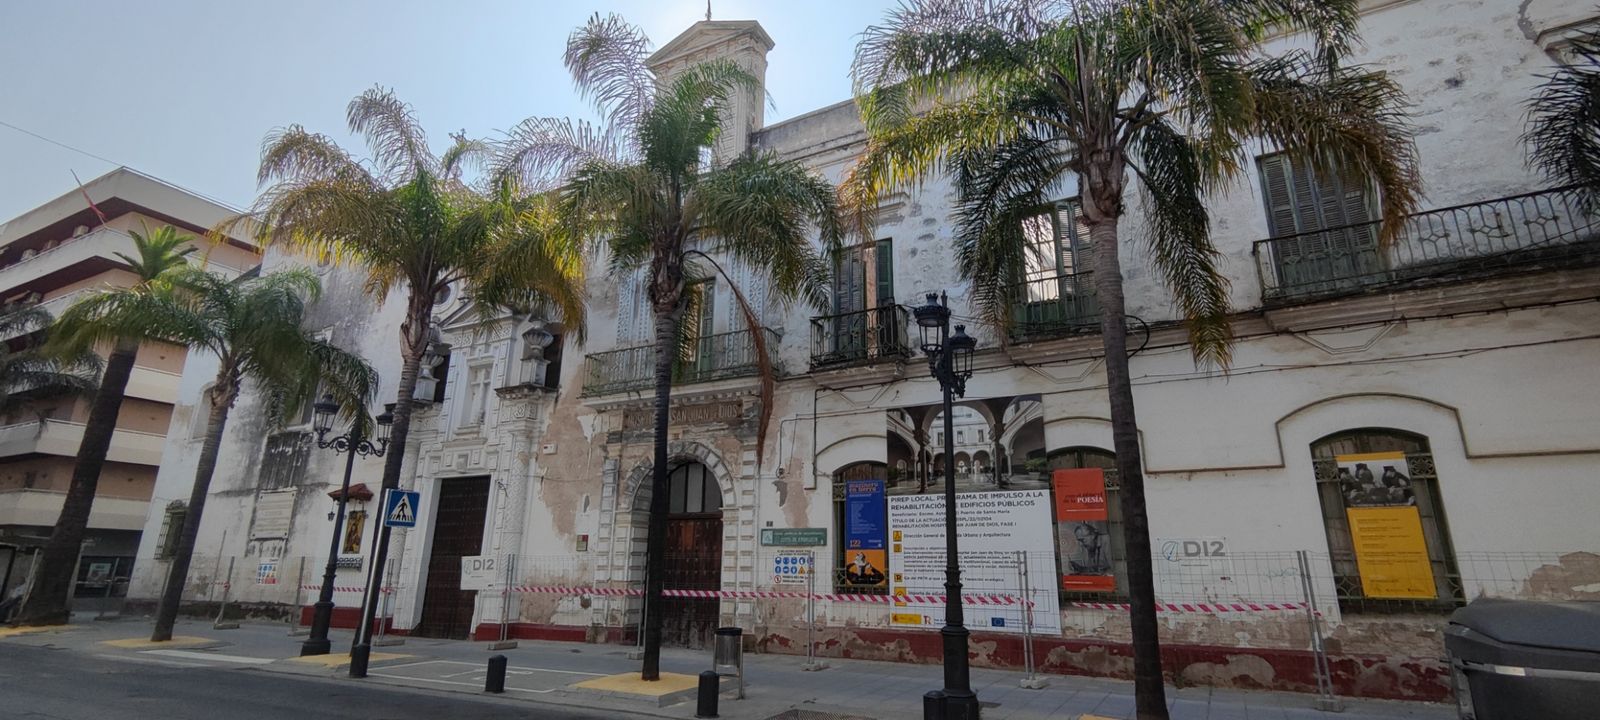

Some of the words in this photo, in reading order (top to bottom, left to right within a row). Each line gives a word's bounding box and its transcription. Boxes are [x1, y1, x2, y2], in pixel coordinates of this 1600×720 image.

[671, 409, 687, 424] SAN
[719, 404, 738, 418] DIOS
[997, 499, 1035, 507] PÚBLICOS
[1077, 495, 1104, 504] POESÍA
[1183, 541, 1226, 557] DI2
[473, 558, 495, 571] DI2
